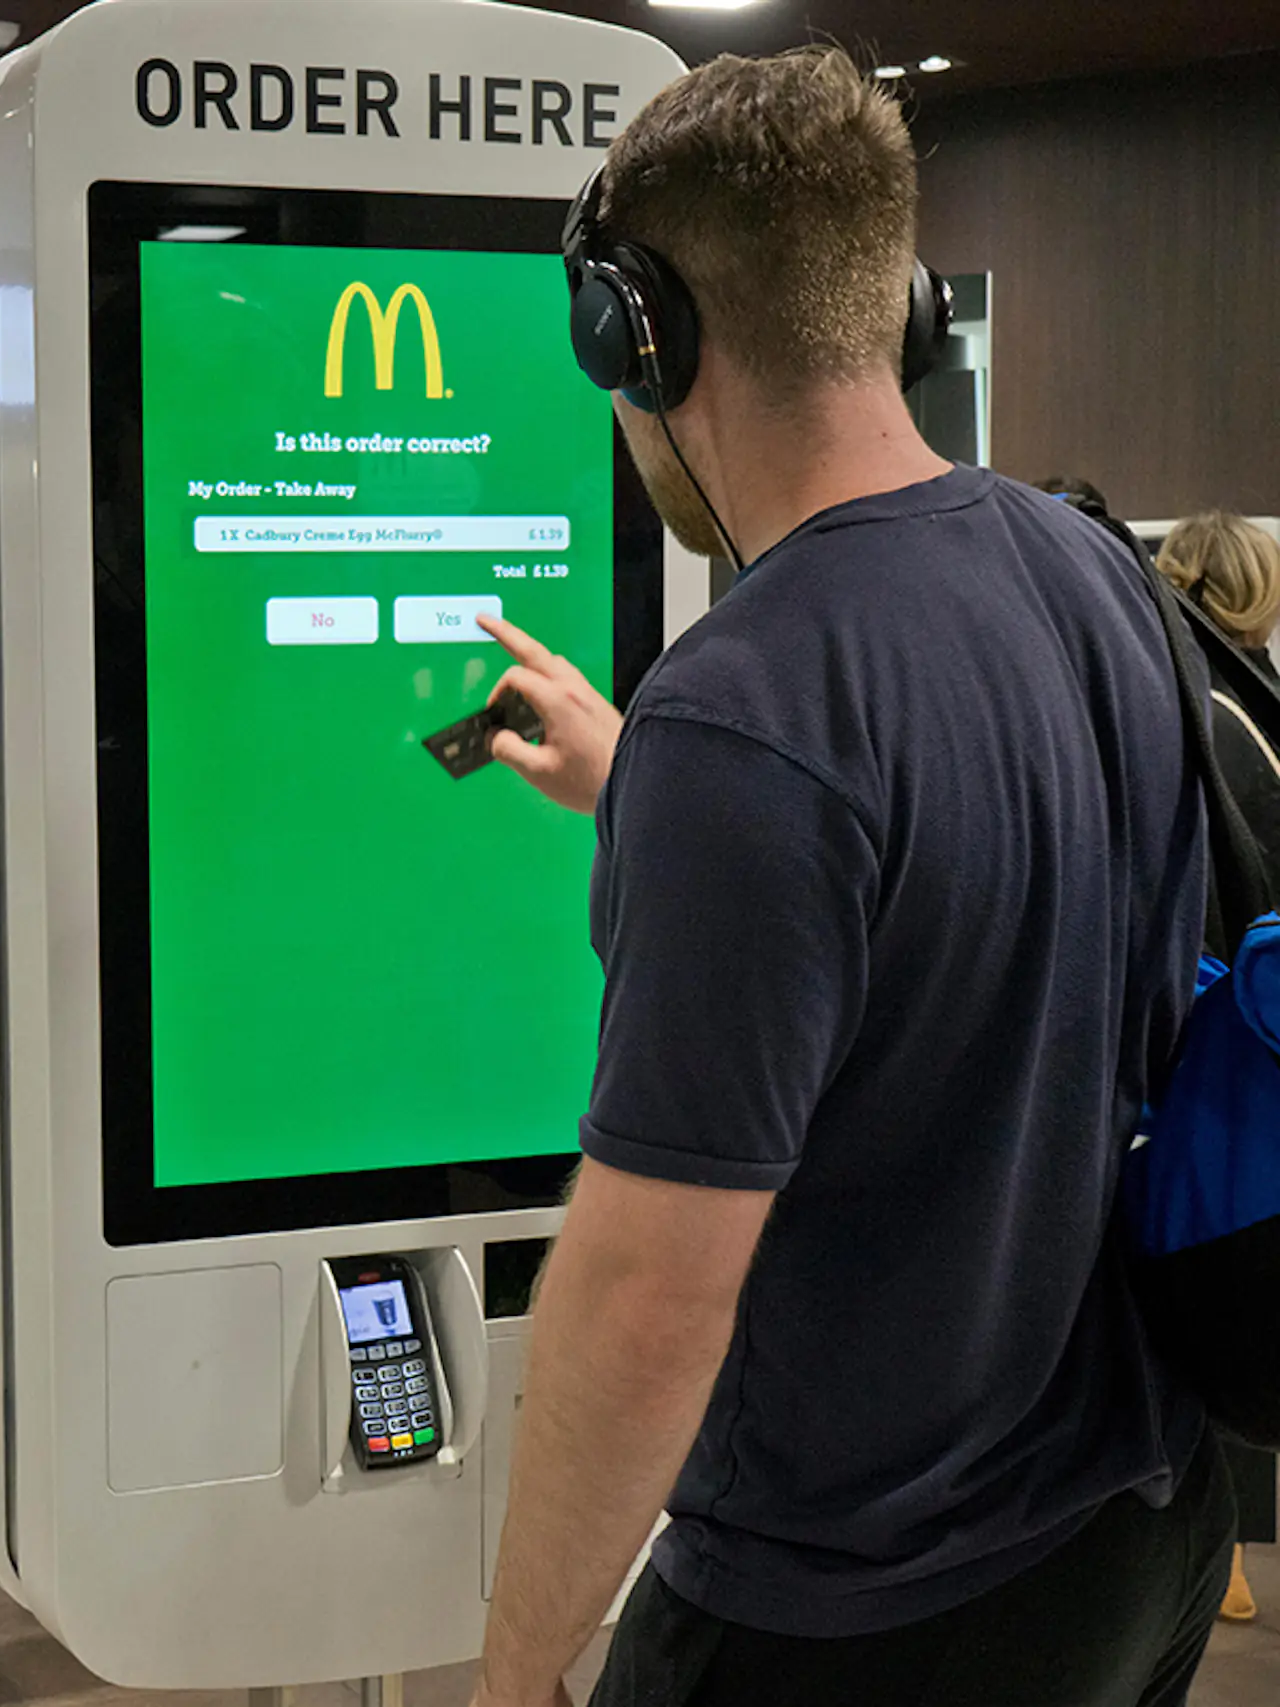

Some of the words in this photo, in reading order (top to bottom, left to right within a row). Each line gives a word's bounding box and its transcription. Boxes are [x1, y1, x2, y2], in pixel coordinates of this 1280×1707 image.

[135, 57, 401, 138] ORDER
[429, 72, 622, 149] HERE
[275, 432, 296, 452] Is
[299, 432, 342, 452] this
[345, 433, 404, 453] order
[407, 434, 492, 454] correct?
[187, 480, 213, 500] My
[215, 480, 262, 497] Order
[274, 481, 312, 497] Take
[314, 481, 357, 500] Away
[245, 529, 300, 543] Cadbury
[304, 529, 345, 541] Creme
[348, 529, 372, 543] Egg
[492, 563, 527, 578] Total
[312, 612, 335, 628] No
[436, 611, 462, 626] Yes
